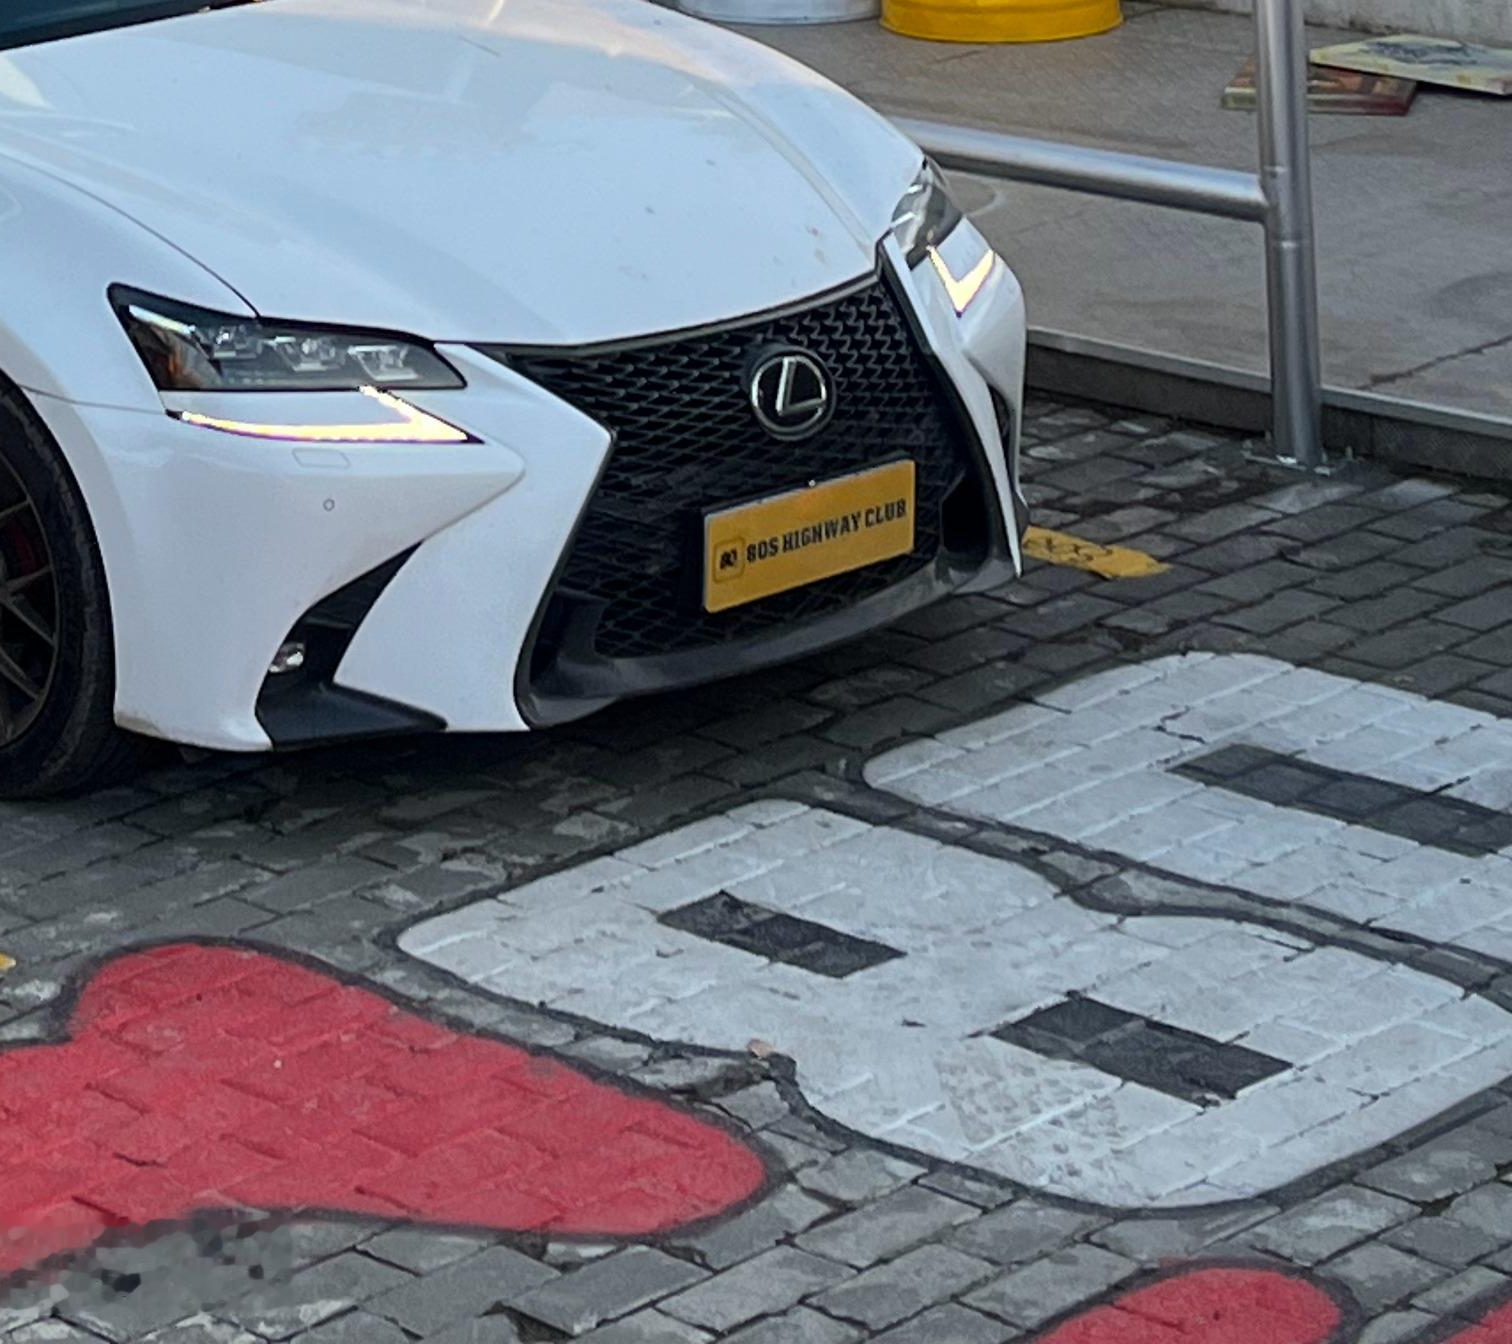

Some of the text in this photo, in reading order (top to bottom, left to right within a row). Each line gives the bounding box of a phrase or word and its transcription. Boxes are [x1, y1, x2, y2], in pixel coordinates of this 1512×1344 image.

[746, 535, 778, 564] 80S
[782, 511, 862, 554] HIGHWAY
[864, 497, 907, 528] CLUB
